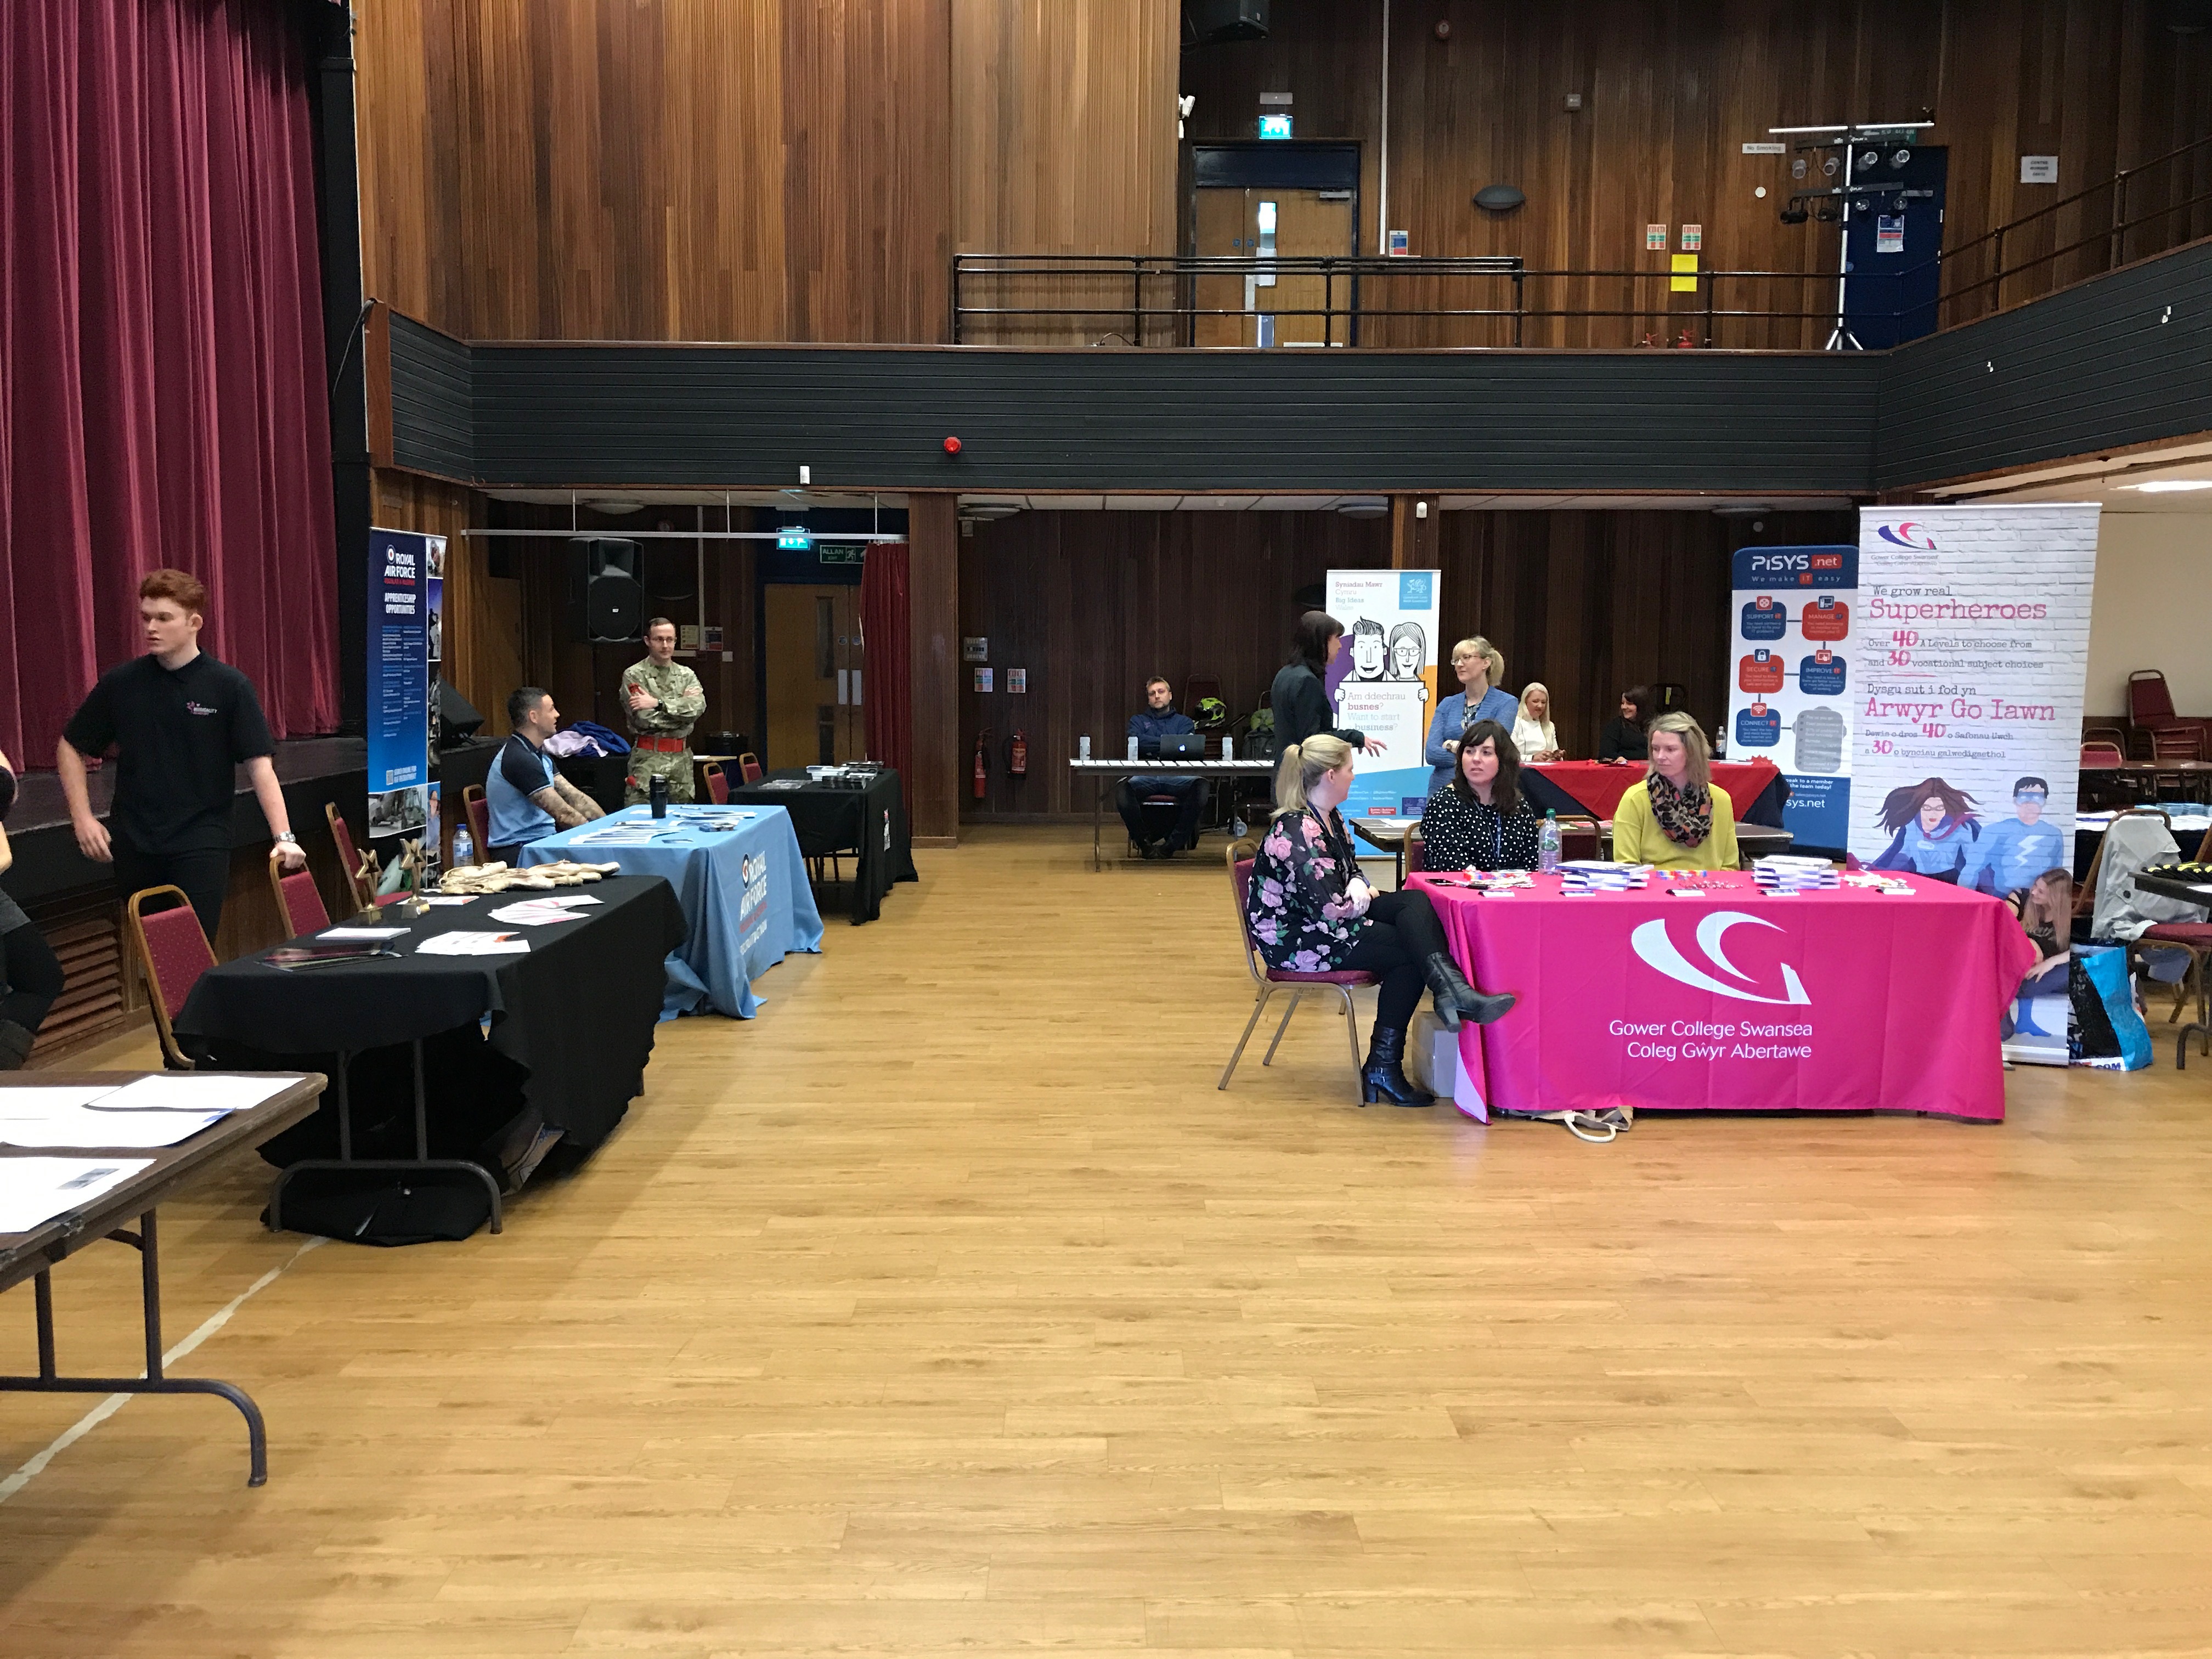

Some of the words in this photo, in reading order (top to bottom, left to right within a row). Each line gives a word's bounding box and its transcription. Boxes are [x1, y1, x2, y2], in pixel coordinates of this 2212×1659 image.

[396, 553, 415, 566] ROYAL
[1814, 557, 1838, 566] .net
[384, 565, 396, 577] AIR
[396, 566, 415, 579] FORCE
[1874, 586, 1887, 596] We
[1891, 588, 1921, 598] grow
[1925, 586, 1952, 596] real
[1870, 598, 2047, 625] Superheroes
[1869, 639, 1891, 648] Over
[1892, 630, 1919, 647] 40
[1928, 640, 1960, 648] Levels
[1974, 640, 2007, 648] choose
[1887, 650, 1911, 666] 30
[1912, 659, 1965, 668] vocational
[1967, 661, 2003, 669] subject
[1366, 692, 1406, 700] ddechrau
[1867, 684, 1901, 696] Dysgu
[1905, 685, 1925, 695] sut
[1928, 685, 1934, 695] i
[1938, 685, 1959, 695] fod
[1961, 686, 1977, 697] yn
[1347, 702, 1384, 710] busnes?
[1865, 697, 1944, 724] Arwyr
[1951, 698, 1983, 720] Go
[1990, 698, 2056, 721] Iawn
[1347, 713, 1369, 721] Want
[1865, 729, 1889, 738] Dewis
[1922, 723, 1947, 738] 40
[1955, 732, 1990, 740] Safonau
[1871, 740, 1893, 754] 30
[1901, 748, 1936, 758] bynciau
[1938, 750, 2006, 759] galwedigaethol
[748, 850, 767, 885] ROYAL
[740, 891, 751, 921] AIR
[750, 874, 767, 910] FORCE
[1609, 1020, 1666, 1036] Gower
[1671, 1020, 1735, 1040] College
[1740, 1021, 1813, 1037] Swansea
[1627, 1042, 1677, 1062] Coleg
[1682, 1041, 1726, 1061] Gŵyr
[1731, 1043, 1812, 1059] Abertawe
